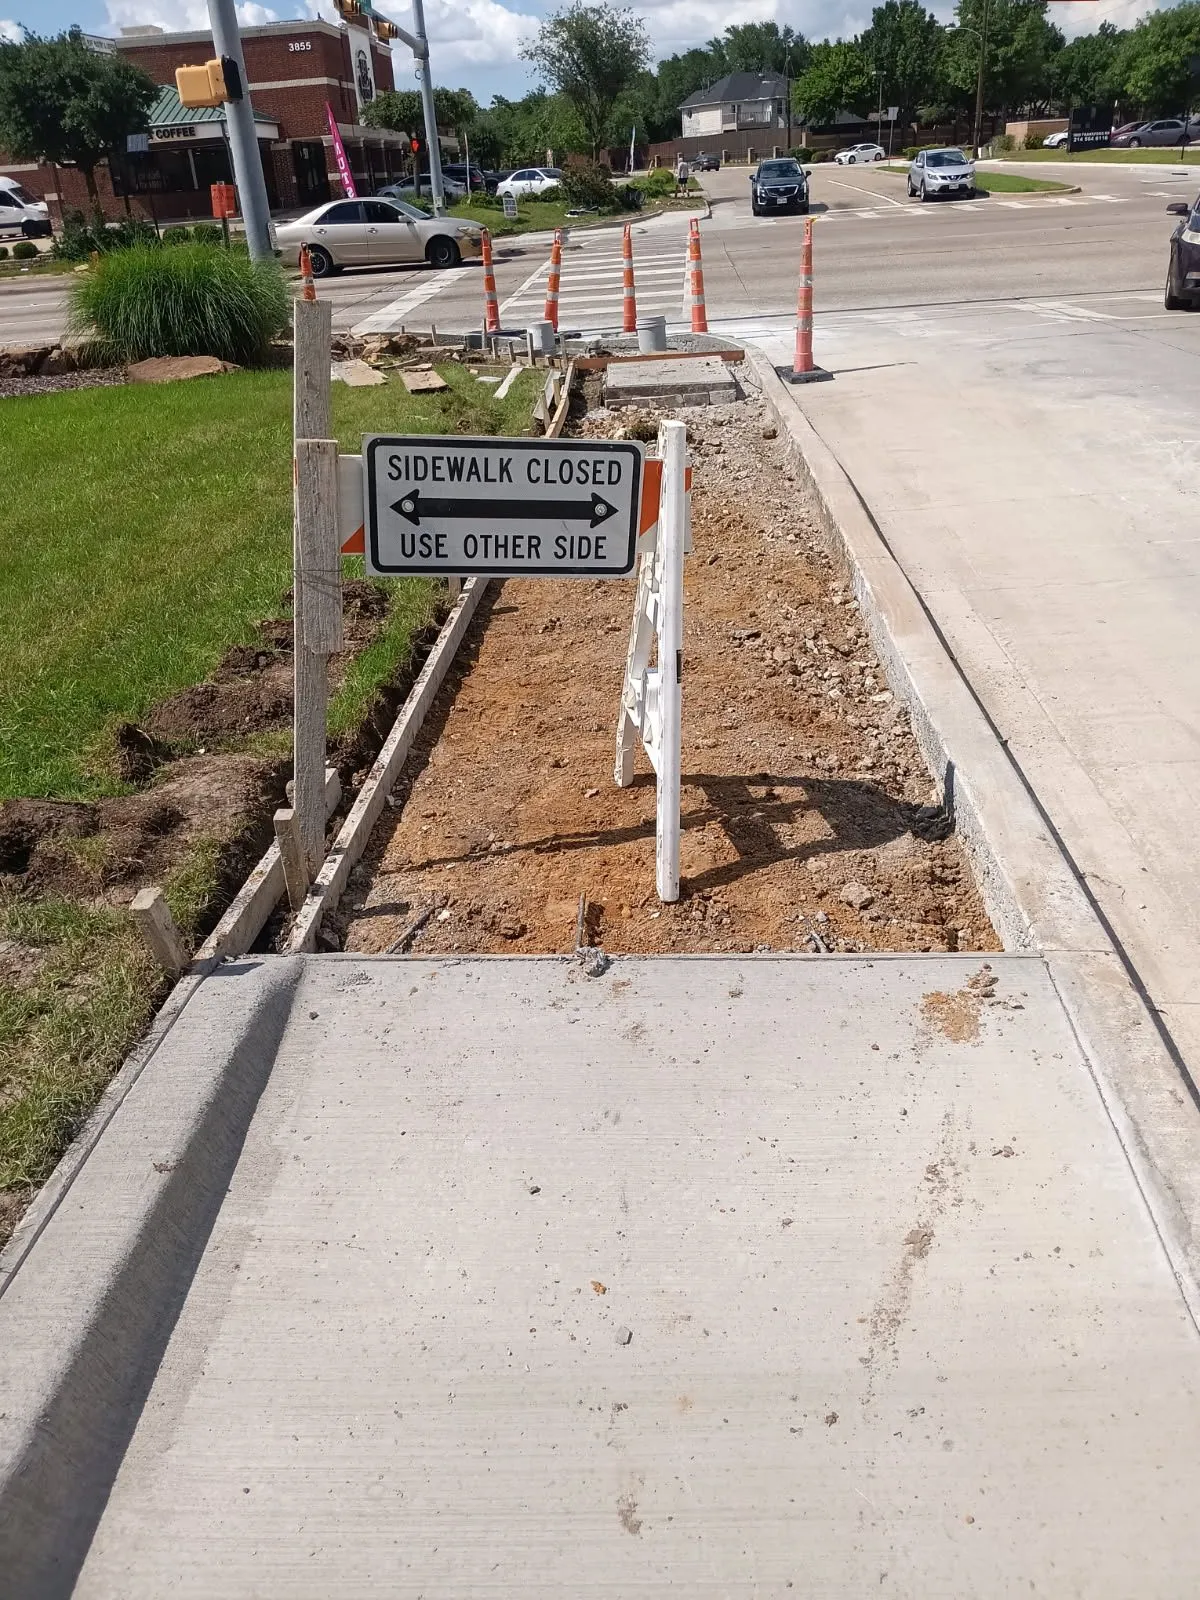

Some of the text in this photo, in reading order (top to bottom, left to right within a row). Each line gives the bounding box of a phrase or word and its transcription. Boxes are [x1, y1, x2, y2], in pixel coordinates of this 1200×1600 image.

[288, 41, 311, 52] 3855
[156, 127, 196, 139] COFFEE
[387, 454, 622, 486] SIDEWALK CLOSED
[400, 533, 607, 560] USE OTHER SIDE
